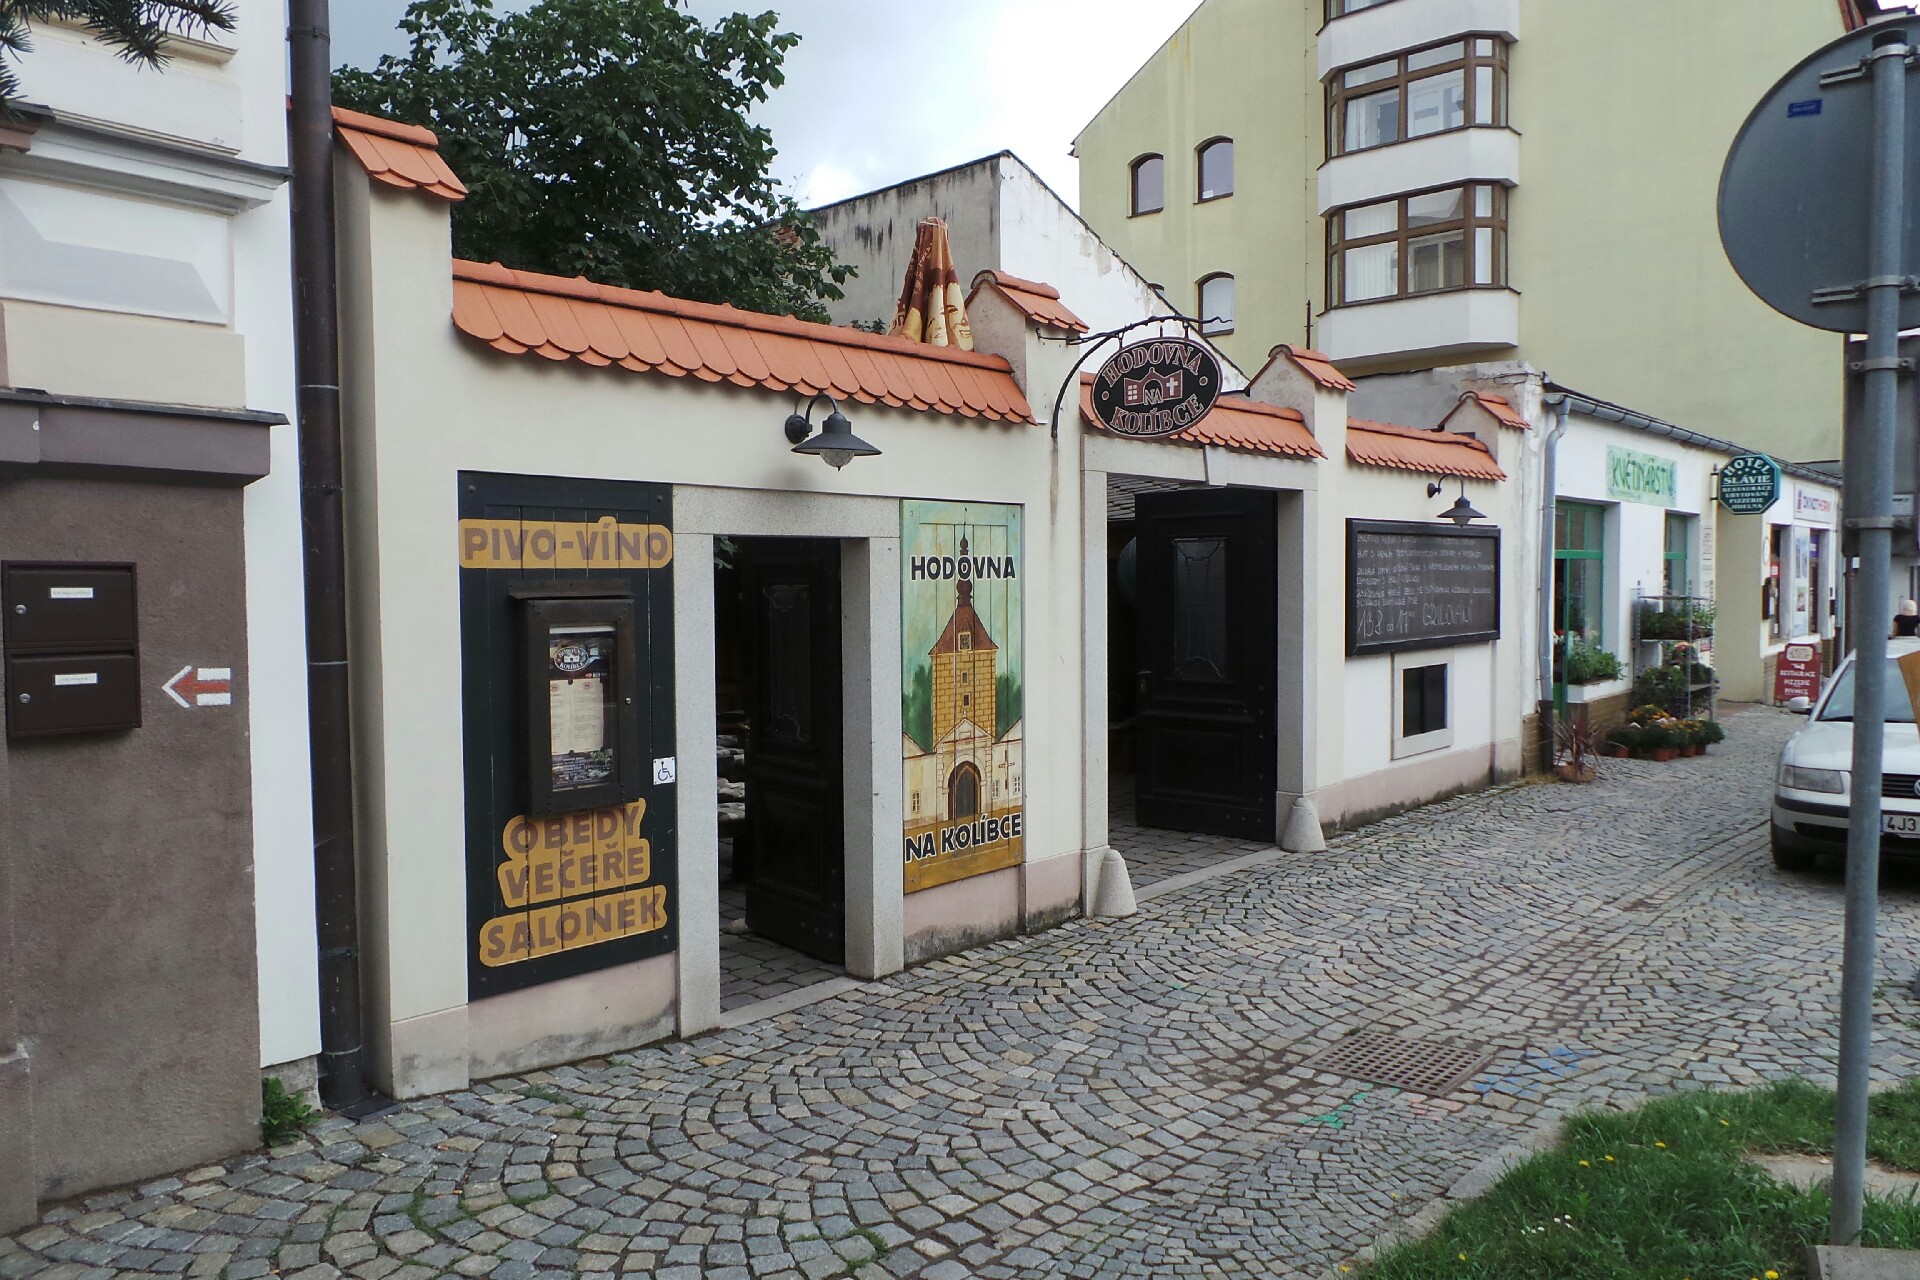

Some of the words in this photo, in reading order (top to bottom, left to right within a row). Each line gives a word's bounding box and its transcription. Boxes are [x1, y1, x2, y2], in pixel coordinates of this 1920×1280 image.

[1101, 342, 1203, 388] HODOVNA
[1110, 393, 1205, 434] KOLÍBCE
[1143, 388, 1164, 406] NA
[1723, 474, 1771, 485] SLÁVIE
[1724, 457, 1771, 476] HOTEL
[1722, 485, 1772, 493] RESTAURACE
[463, 522, 669, 562] PIVO-VÍNO
[910, 555, 1016, 581] HODOVNA
[906, 833, 936, 862] NA
[941, 813, 1022, 853] KOLÍBCE
[1887, 816, 1916, 832] 4J3
[504, 841, 645, 900] VEČEŘE
[486, 892, 661, 959] SALONEK
